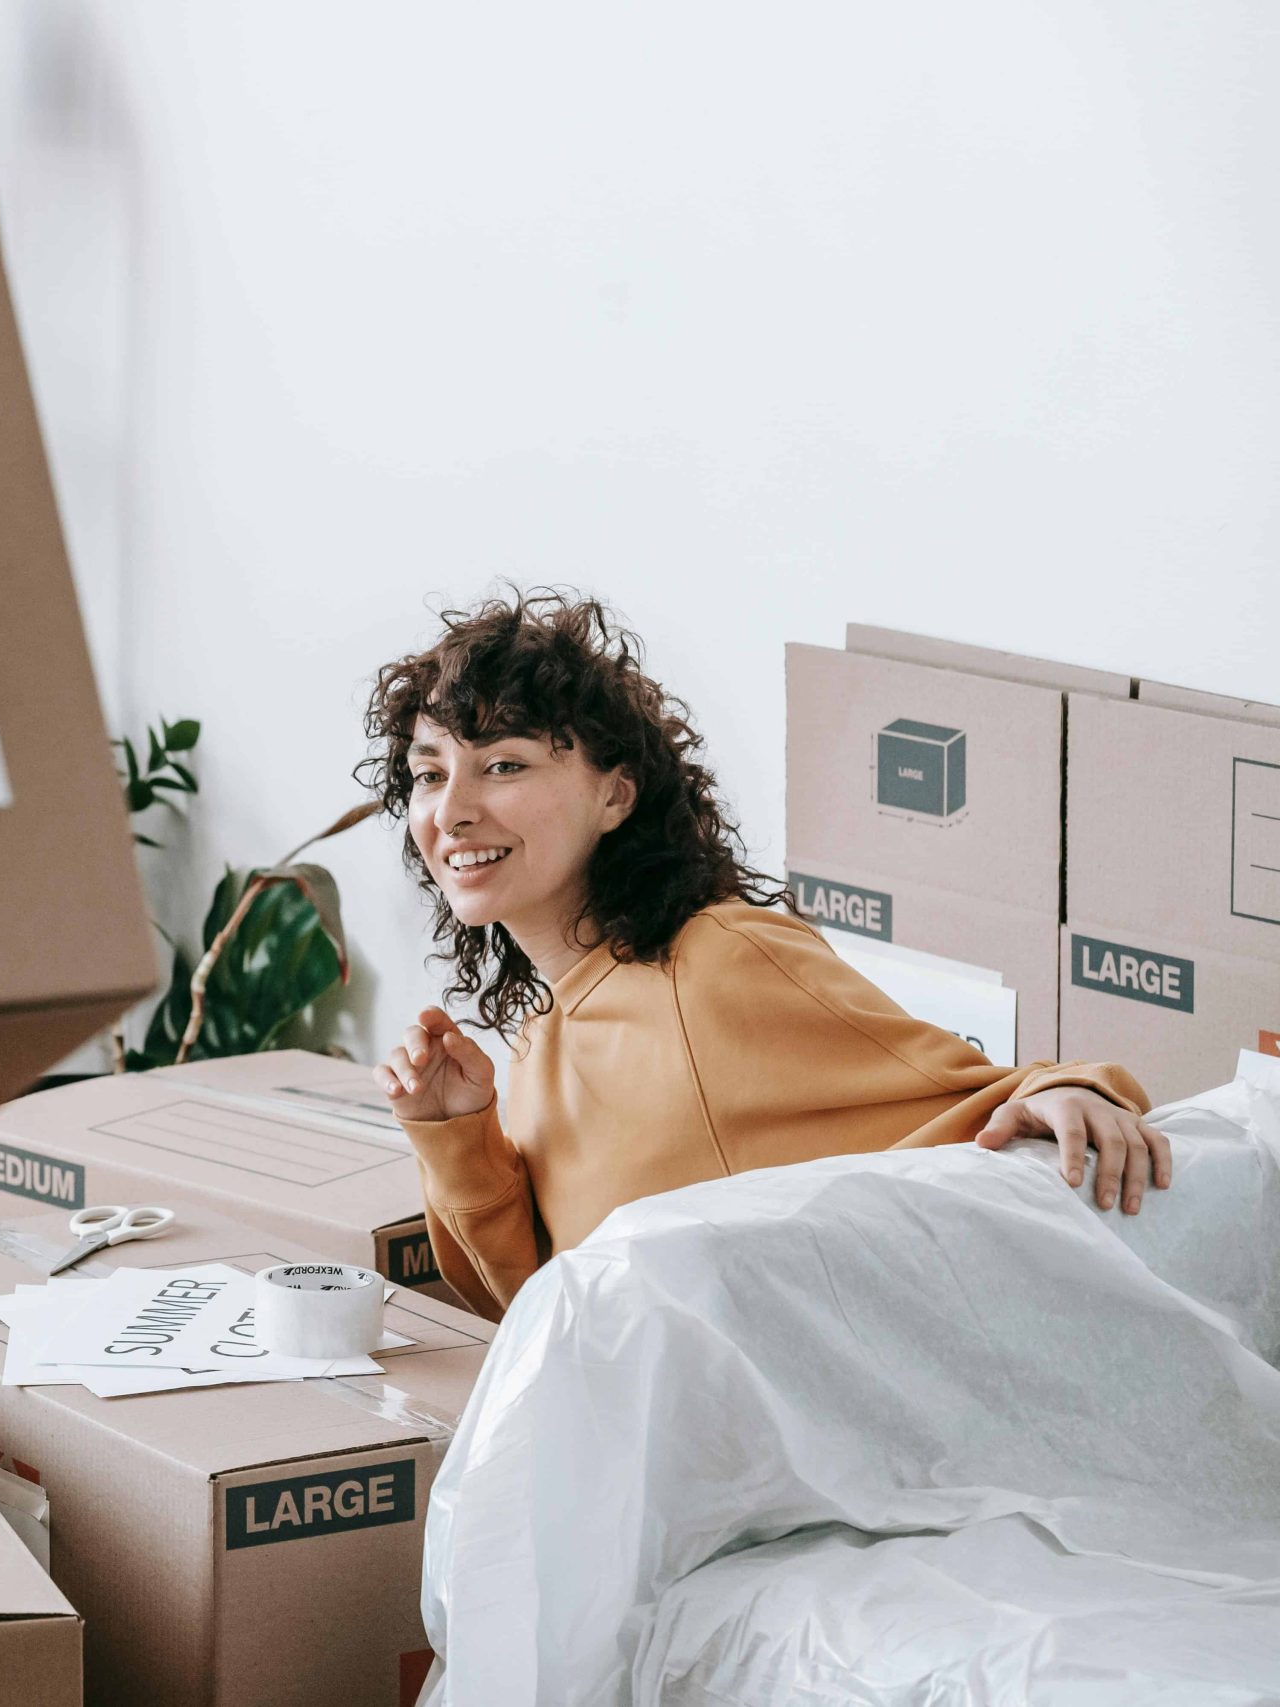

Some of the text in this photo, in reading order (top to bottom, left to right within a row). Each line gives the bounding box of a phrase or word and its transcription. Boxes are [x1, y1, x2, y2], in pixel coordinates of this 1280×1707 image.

[898, 766, 923, 781] LARGE
[797, 882, 882, 932] LARGE
[1082, 945, 1181, 1000] LARGE
[104, 1279, 228, 1356] SUMMER
[246, 1473, 395, 1534] LARGE
